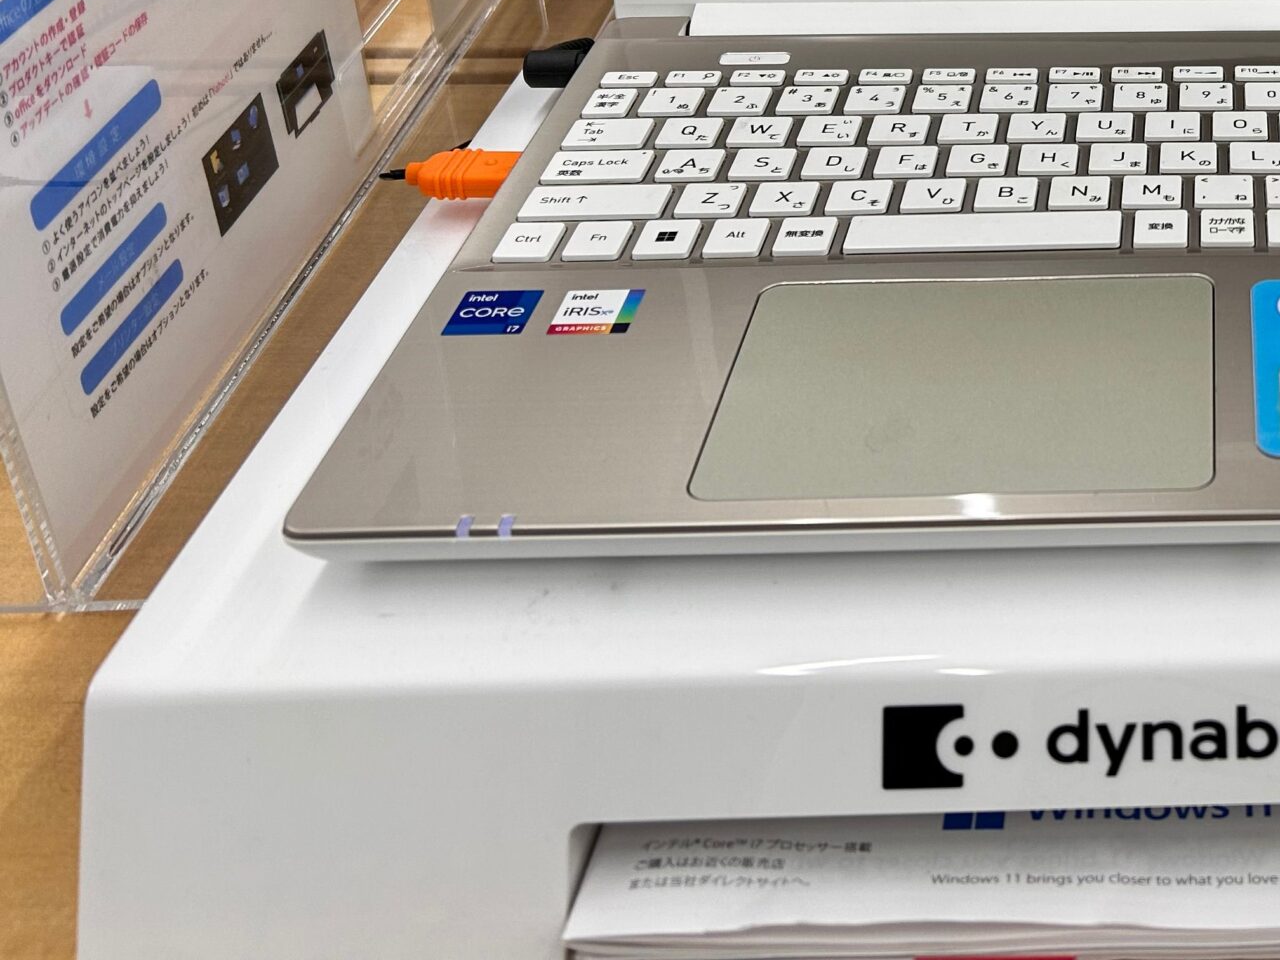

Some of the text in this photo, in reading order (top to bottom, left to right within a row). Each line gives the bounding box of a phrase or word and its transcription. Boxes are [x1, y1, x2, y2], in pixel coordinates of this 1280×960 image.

[583, 128, 604, 136] Tab
[681, 125, 697, 137] Q
[750, 124, 773, 135] W
[822, 123, 837, 134] E
[562, 157, 629, 168] Caps Lock
[539, 195, 572, 205] Shift
[1148, 222, 1174, 231] 変換
[590, 234, 607, 242] Fn
[726, 230, 746, 238] Alt
[515, 235, 542, 244] Ctrl
[468, 293, 499, 302] intel
[571, 293, 599, 302] intel
[930, 872, 1000, 885] Windows
[1026, 872, 1073, 888] brings
[1077, 875, 1105, 888] you
[1109, 872, 1152, 886] closer
[1156, 875, 1172, 887] to
[1175, 873, 1212, 887] what
[1215, 876, 1244, 888] you
[1248, 873, 1280, 886] love
